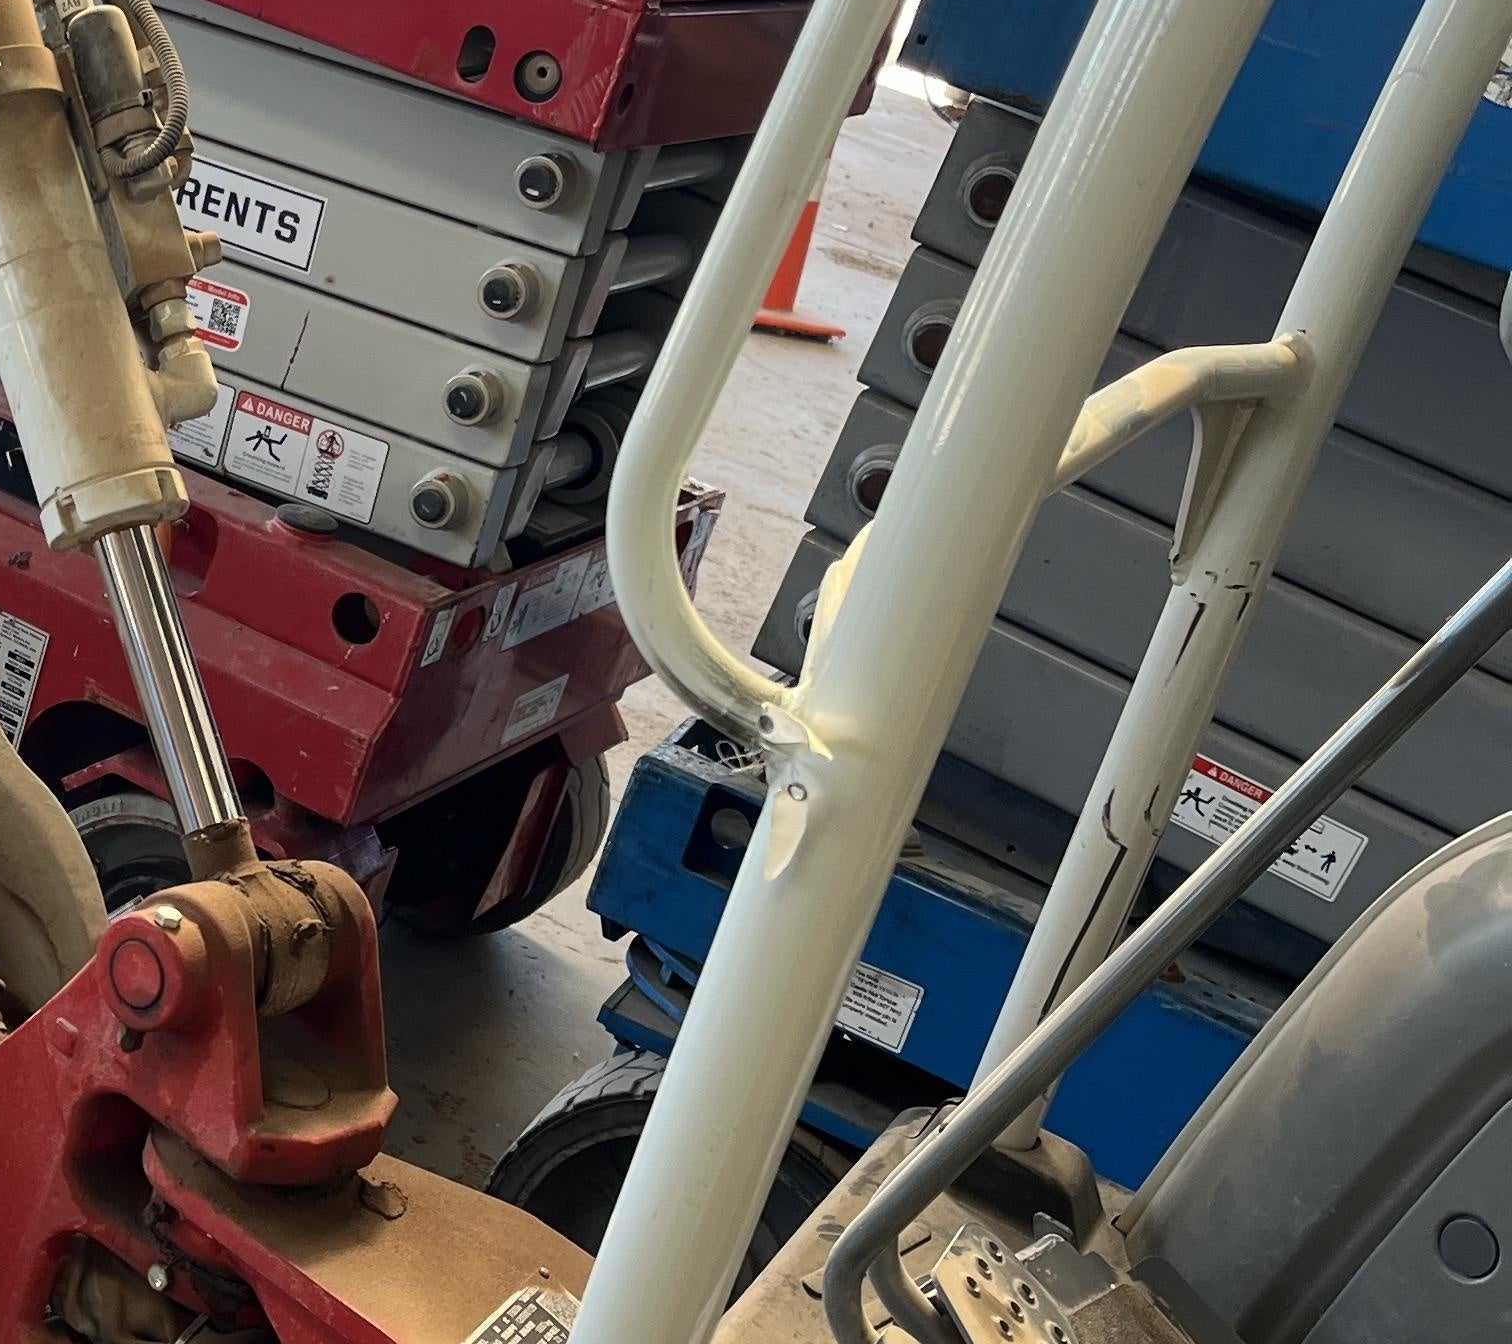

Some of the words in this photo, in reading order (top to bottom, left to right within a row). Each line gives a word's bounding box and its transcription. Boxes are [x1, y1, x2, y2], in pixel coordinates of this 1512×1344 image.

[176, 177, 301, 244] RENTS
[255, 401, 311, 431] DANGER
[1218, 771, 1264, 800] DANGER
